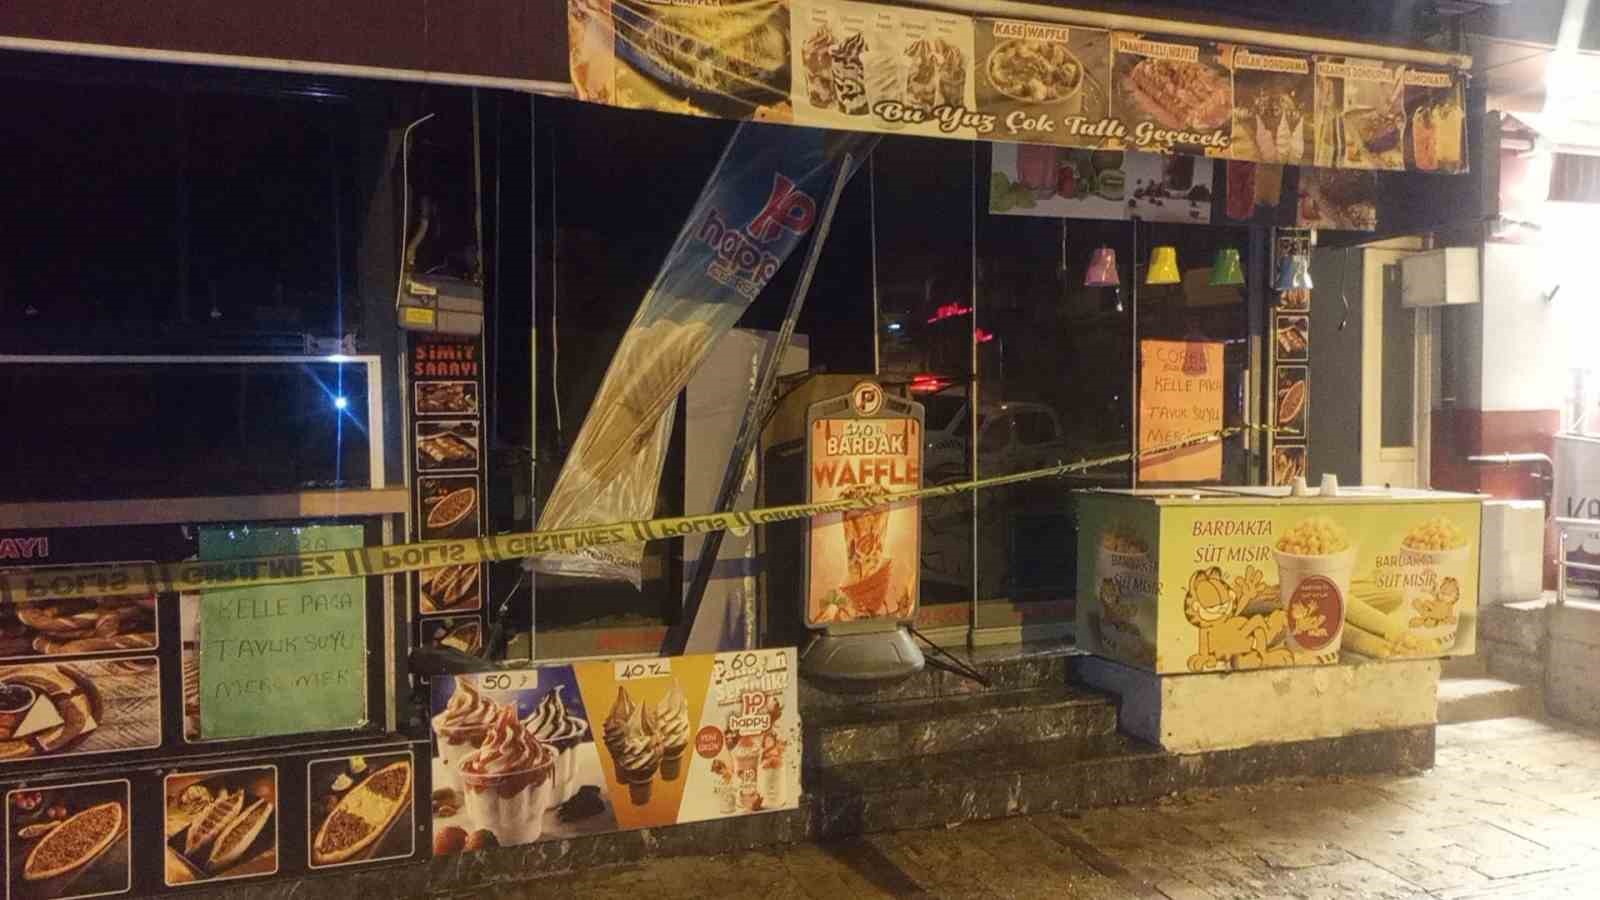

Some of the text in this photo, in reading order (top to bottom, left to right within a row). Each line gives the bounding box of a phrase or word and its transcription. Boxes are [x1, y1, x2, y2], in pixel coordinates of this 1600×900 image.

[1027, 26, 1067, 40] WAFFLE
[934, 104, 996, 133] Yaz
[1006, 110, 1055, 136] Çok
[1135, 120, 1232, 149] Geçecek
[415, 362, 478, 375] SARAYI
[1154, 376, 1192, 392] KELLE
[827, 433, 906, 457] BARDAK
[814, 458, 919, 488] WAFFLE
[1192, 519, 1273, 536] BARDAKTA
[1193, 543, 1272, 563] SÜT MISIR
[218, 597, 289, 621] KELLE
[213, 637, 297, 663] TAVUK
[731, 652, 758, 670] 60
[483, 673, 512, 691] 50
[730, 715, 770, 731] happy
